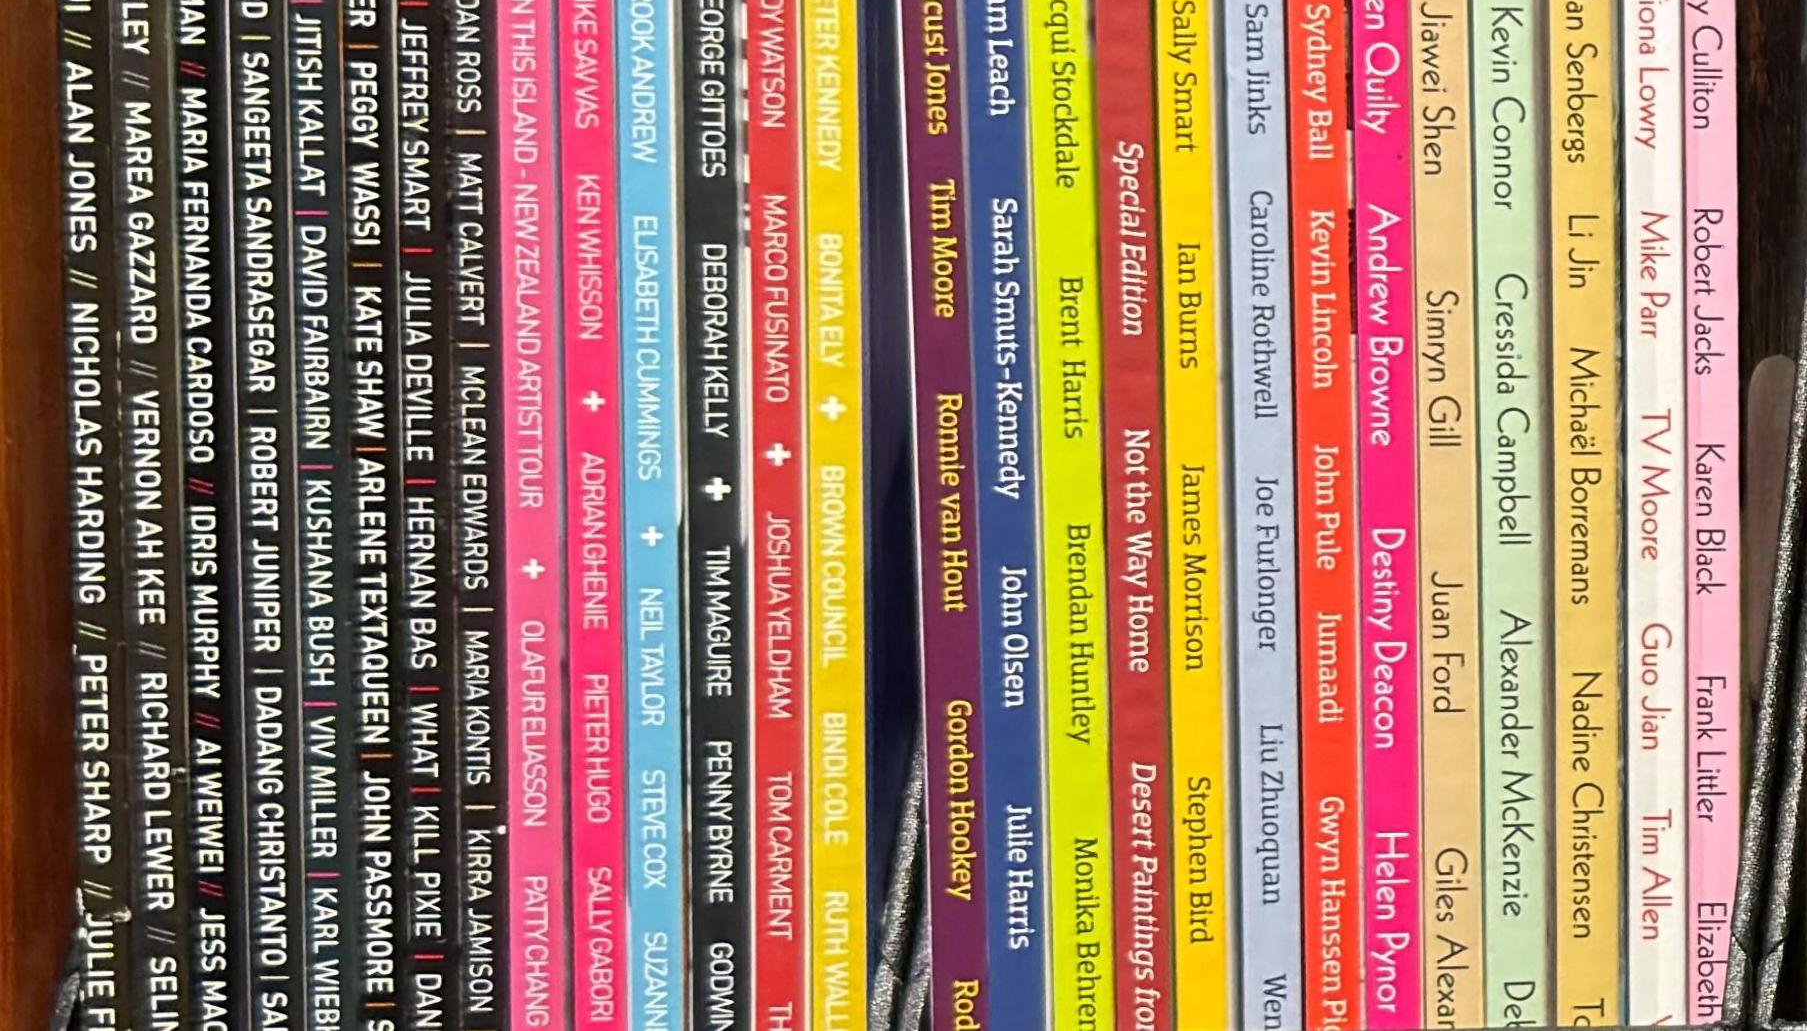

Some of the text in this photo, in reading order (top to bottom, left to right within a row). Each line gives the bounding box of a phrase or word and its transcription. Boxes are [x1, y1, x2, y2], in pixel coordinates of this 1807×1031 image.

[575, 40, 598, 128] SAVVAS
[700, 81, 725, 177] GITTOES
[816, 54, 841, 171] KENNEDY
[924, 62, 950, 135] Jones
[1052, 61, 1080, 188] Stockdale
[1167, 0, 1199, 152] Sally Smart
[1360, 41, 1398, 134] Quilty
[1418, 1, 1453, 176] Jiawei Shen
[1563, 42, 1597, 164] Senbergs
[1634, 68, 1668, 149] Lowry
[1123, 428, 1153, 672] Not the Way Home
[1317, 612, 1344, 723] Jumaadi
[139, 672, 172, 909] RICHARD LEWER
[1499, 610, 1533, 917] Alexander McKenzie
[766, 772, 793, 940] TOM CARMENT
